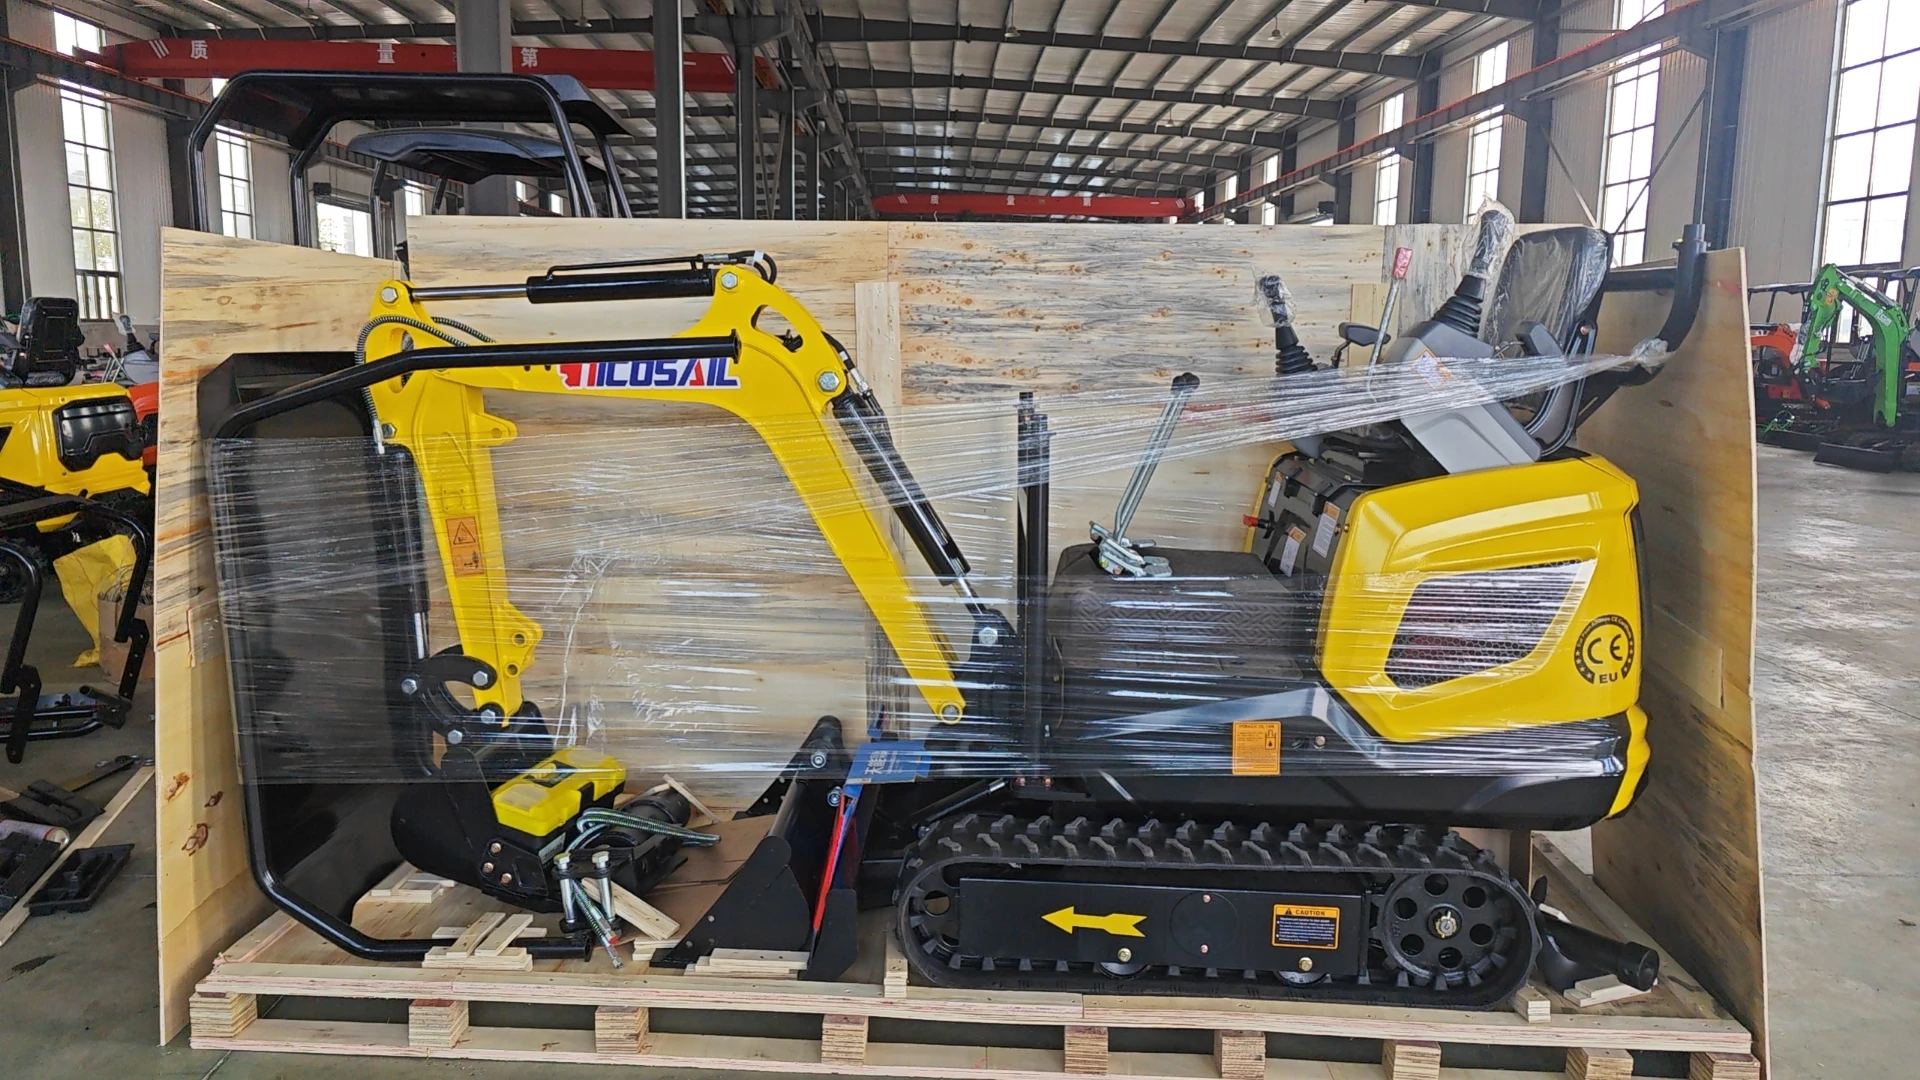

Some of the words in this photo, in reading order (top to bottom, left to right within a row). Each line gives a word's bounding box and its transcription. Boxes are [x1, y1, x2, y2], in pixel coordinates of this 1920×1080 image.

[190, 39, 209, 60] 质
[377, 43, 396, 64] 量
[520, 47, 539, 68] 第
[1587, 633, 1623, 665] CE
[1599, 672, 1618, 684] EU
